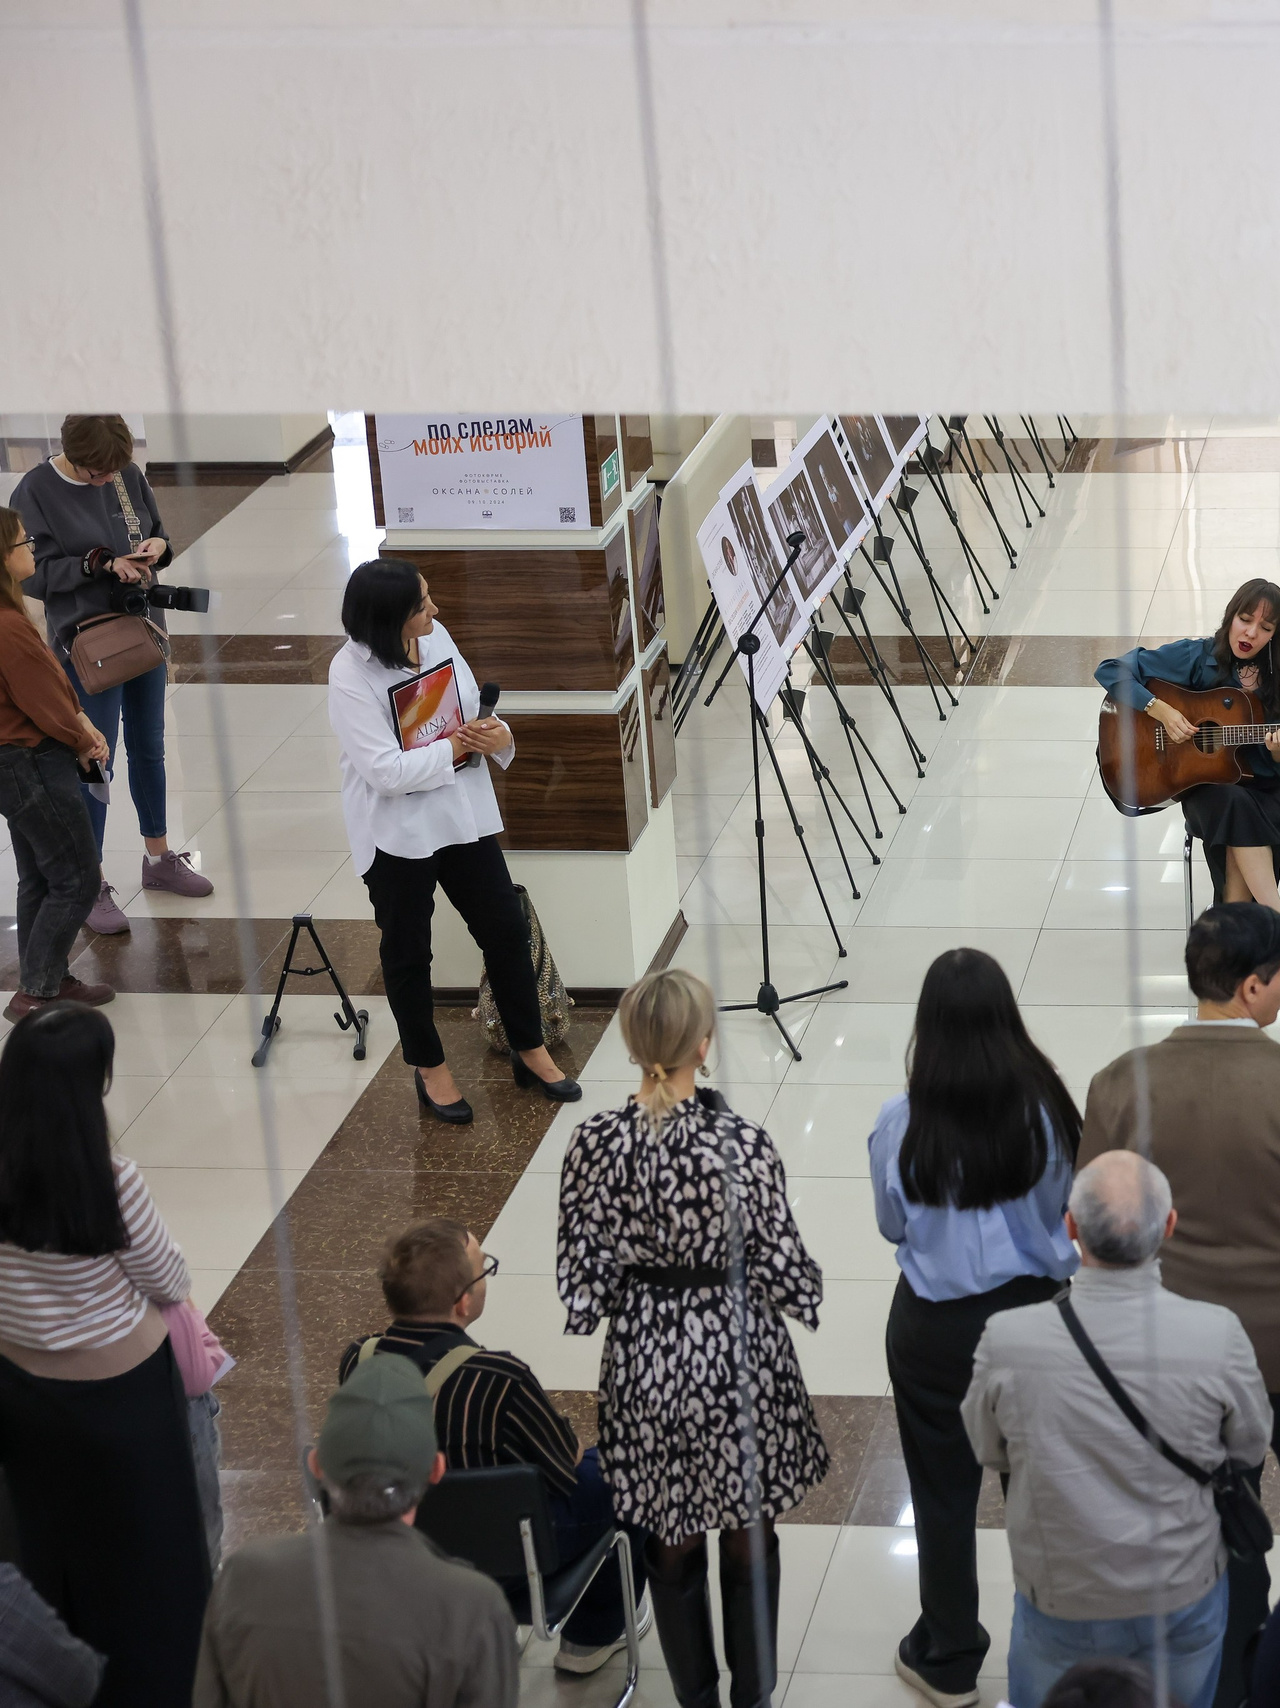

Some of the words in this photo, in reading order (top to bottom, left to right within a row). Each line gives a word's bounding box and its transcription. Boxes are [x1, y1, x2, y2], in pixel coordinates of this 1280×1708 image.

[427, 423, 451, 440] по
[457, 418, 534, 440] следам
[413, 436, 464, 456] моих
[469, 425, 552, 454] историй
[432, 487, 481, 495] ОКСАНА
[492, 487, 533, 495] СОЛЕЙ
